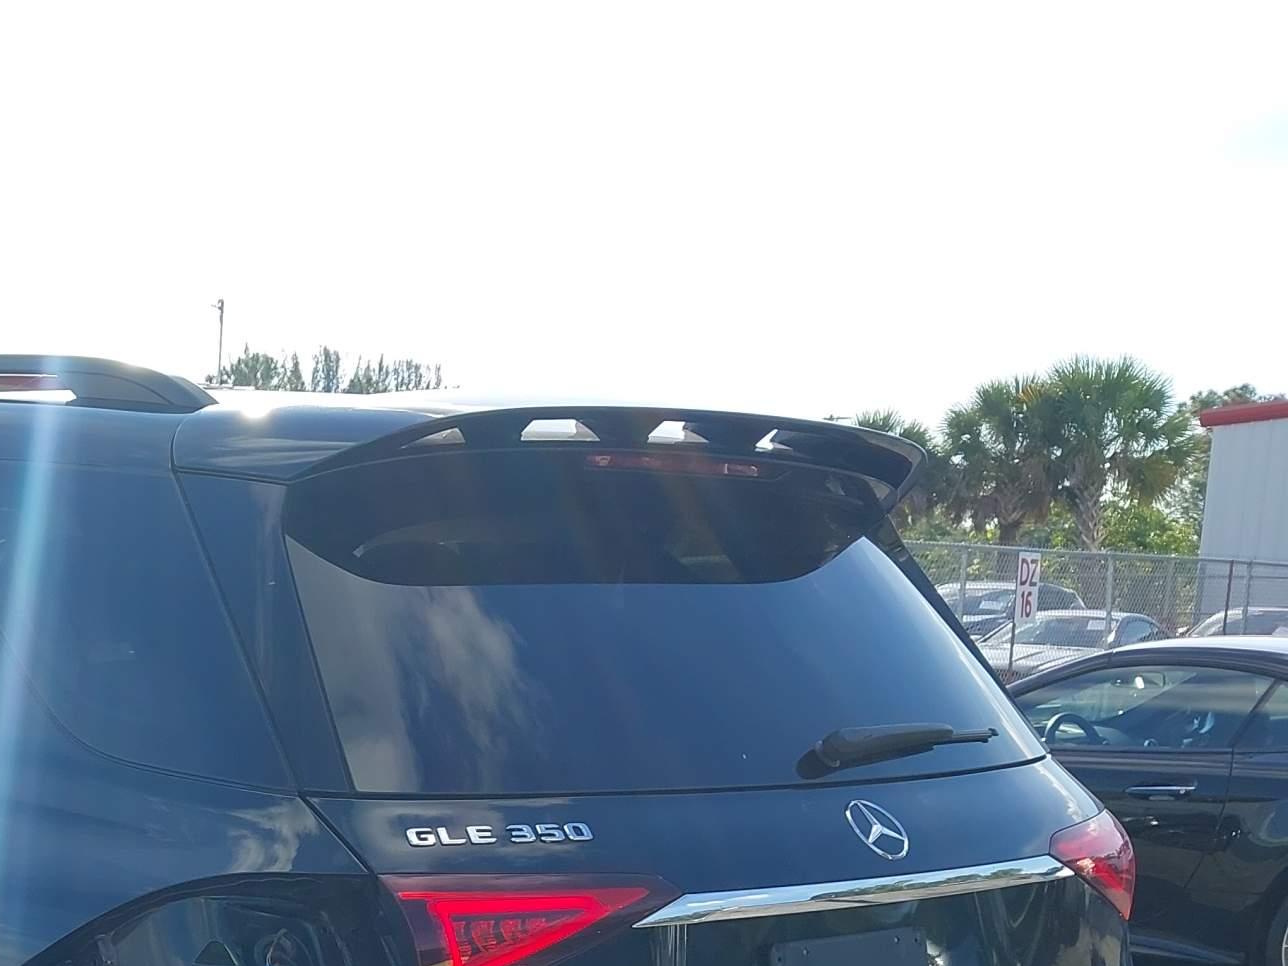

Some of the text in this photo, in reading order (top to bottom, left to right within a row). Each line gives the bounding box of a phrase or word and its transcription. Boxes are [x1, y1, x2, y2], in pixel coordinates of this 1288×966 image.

[1021, 591, 1032, 618] 16
[405, 822, 594, 847] GLE 350
